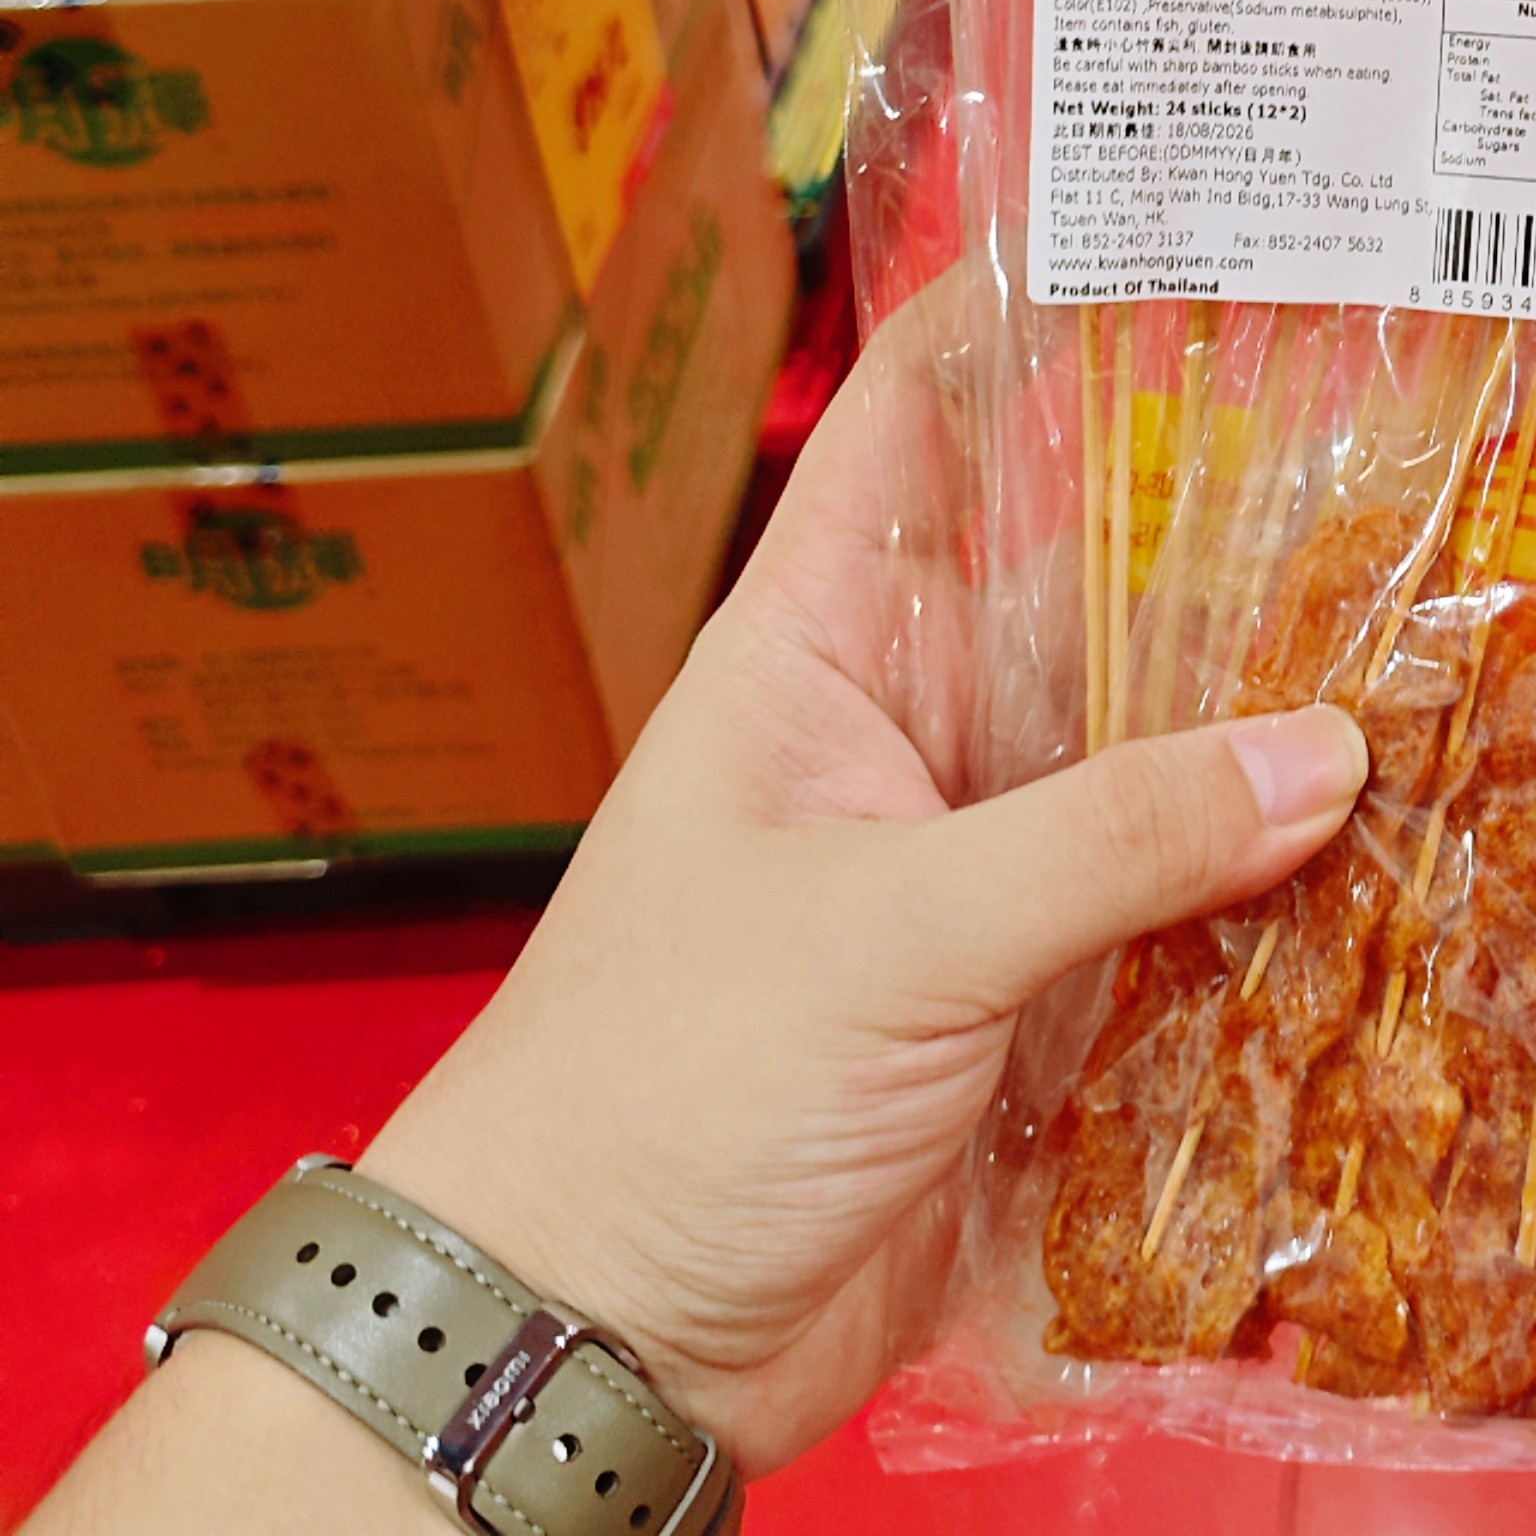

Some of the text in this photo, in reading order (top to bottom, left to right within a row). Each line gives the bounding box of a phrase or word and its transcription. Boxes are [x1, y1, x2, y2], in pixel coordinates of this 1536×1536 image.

[1054, 15, 1235, 36] Item contains fish, gluten.
[1448, 34, 1491, 52] Energy
[1447, 51, 1490, 66] Protein
[1053, 57, 1393, 85] Be careful with sharp bamboo sticks when eating.
[1447, 67, 1477, 83] Total
[1053, 77, 1097, 93] Please
[1102, 80, 1125, 93] eat
[1130, 78, 1210, 96] immediately
[1214, 79, 1247, 95] after
[1053, 99, 1084, 115] Net
[1090, 99, 1160, 119] Weight:
[1166, 100, 1186, 115] 24
[1191, 101, 1242, 116] sticks
[1479, 105, 1514, 120] Trans
[1168, 122, 1254, 140] 18/08/2026
[1442, 120, 1527, 138] Carbohydrate
[1051, 143, 1092, 162] BEST
[1477, 137, 1520, 154] Sugars
[1440, 151, 1487, 167] Sodium
[1051, 165, 1393, 190] Distributed By: Kwan Hong Yuen Tdg. Co. Ltd
[1051, 189, 1079, 205] Flat
[1086, 189, 1103, 205] 11
[1110, 189, 1124, 207] C,
[1130, 189, 1164, 207] Ming
[1168, 188, 1201, 204] Wah
[1207, 188, 1232, 205] Ind
[1326, 194, 1369, 212] Wang
[1375, 195, 1410, 215] Lung
[1050, 210, 1097, 227] Tsuen
[1102, 210, 1140, 230] Wan,
[1158, 231, 1194, 248] 3137
[1347, 235, 1384, 253] 5632
[1049, 276, 1220, 298] Product Of Thailand
[1408, 285, 1421, 304] 8
